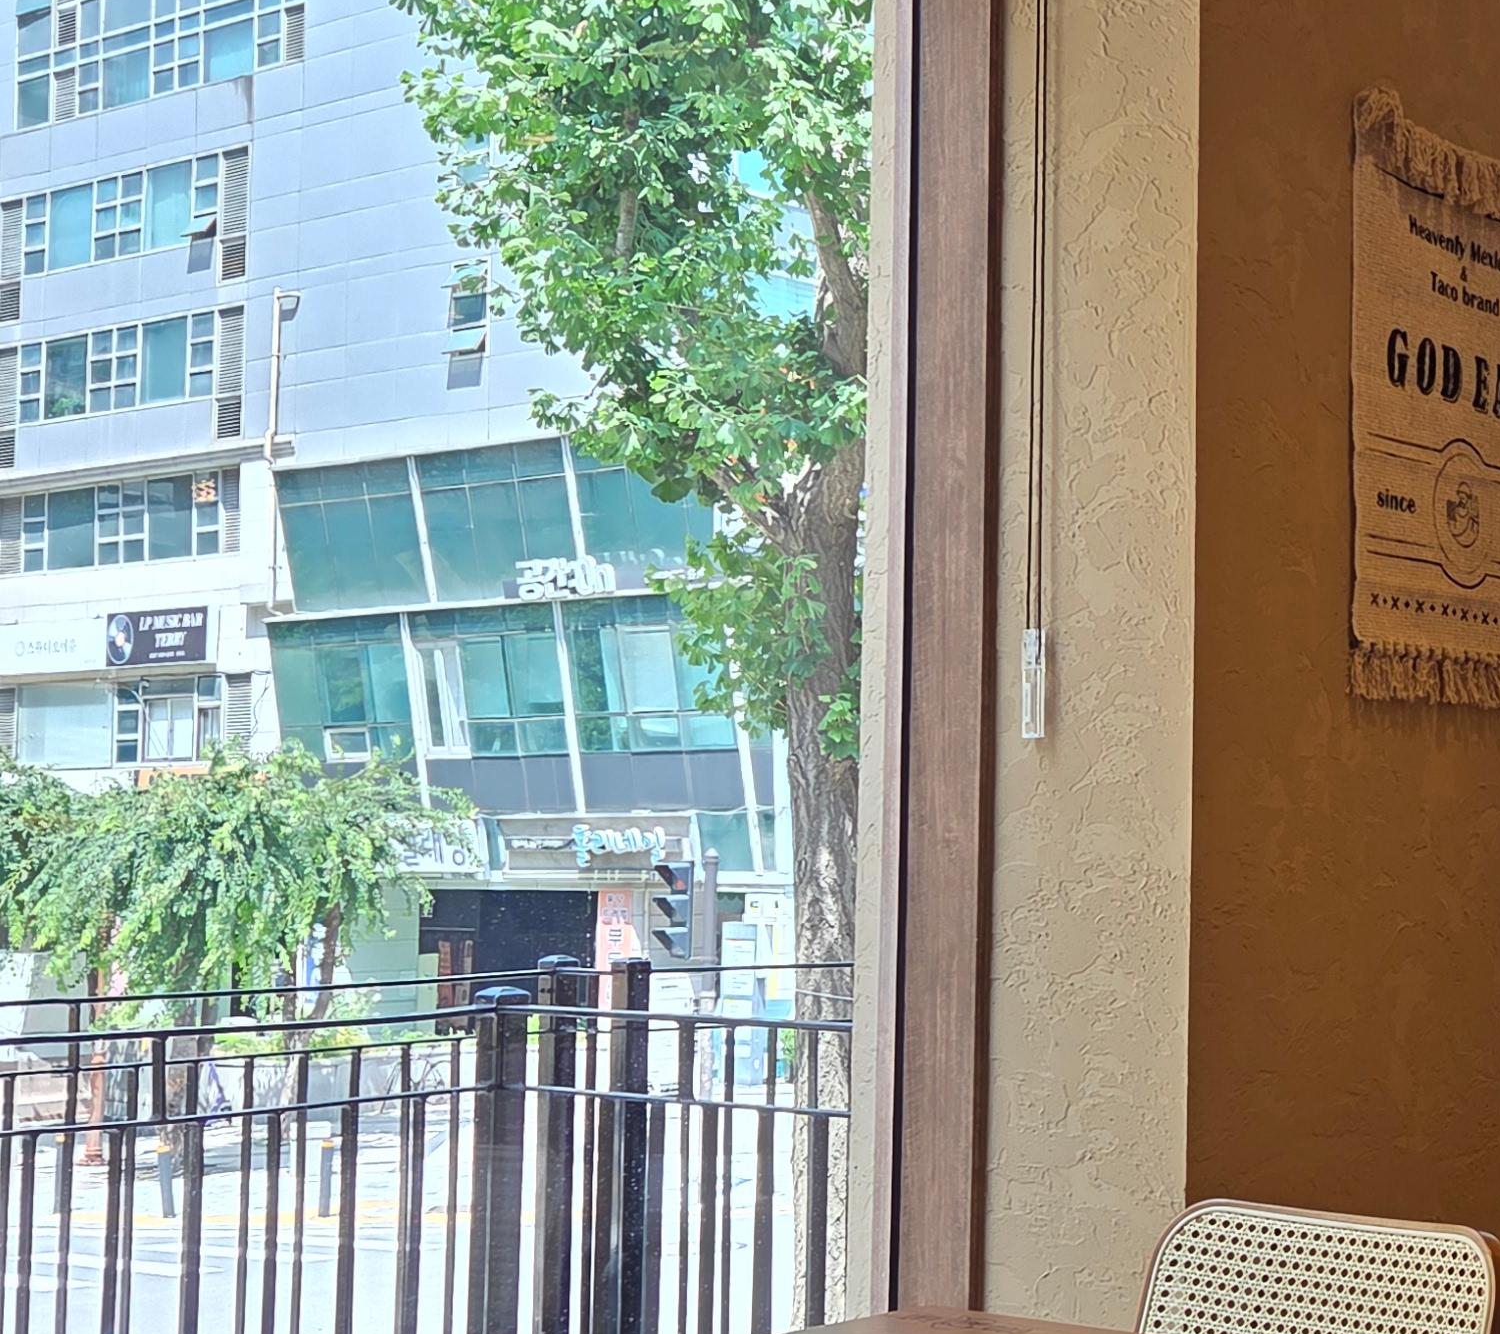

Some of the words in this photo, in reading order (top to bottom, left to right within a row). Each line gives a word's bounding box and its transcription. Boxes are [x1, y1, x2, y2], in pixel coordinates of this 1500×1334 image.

[1408, 214, 1465, 262] Heavenly
[1430, 270, 1459, 302] Taco
[1462, 285, 1500, 317] brand
[1460, 265, 1468, 283] &
[1387, 328, 1463, 403] GOD
[1376, 488, 1417, 514] since
